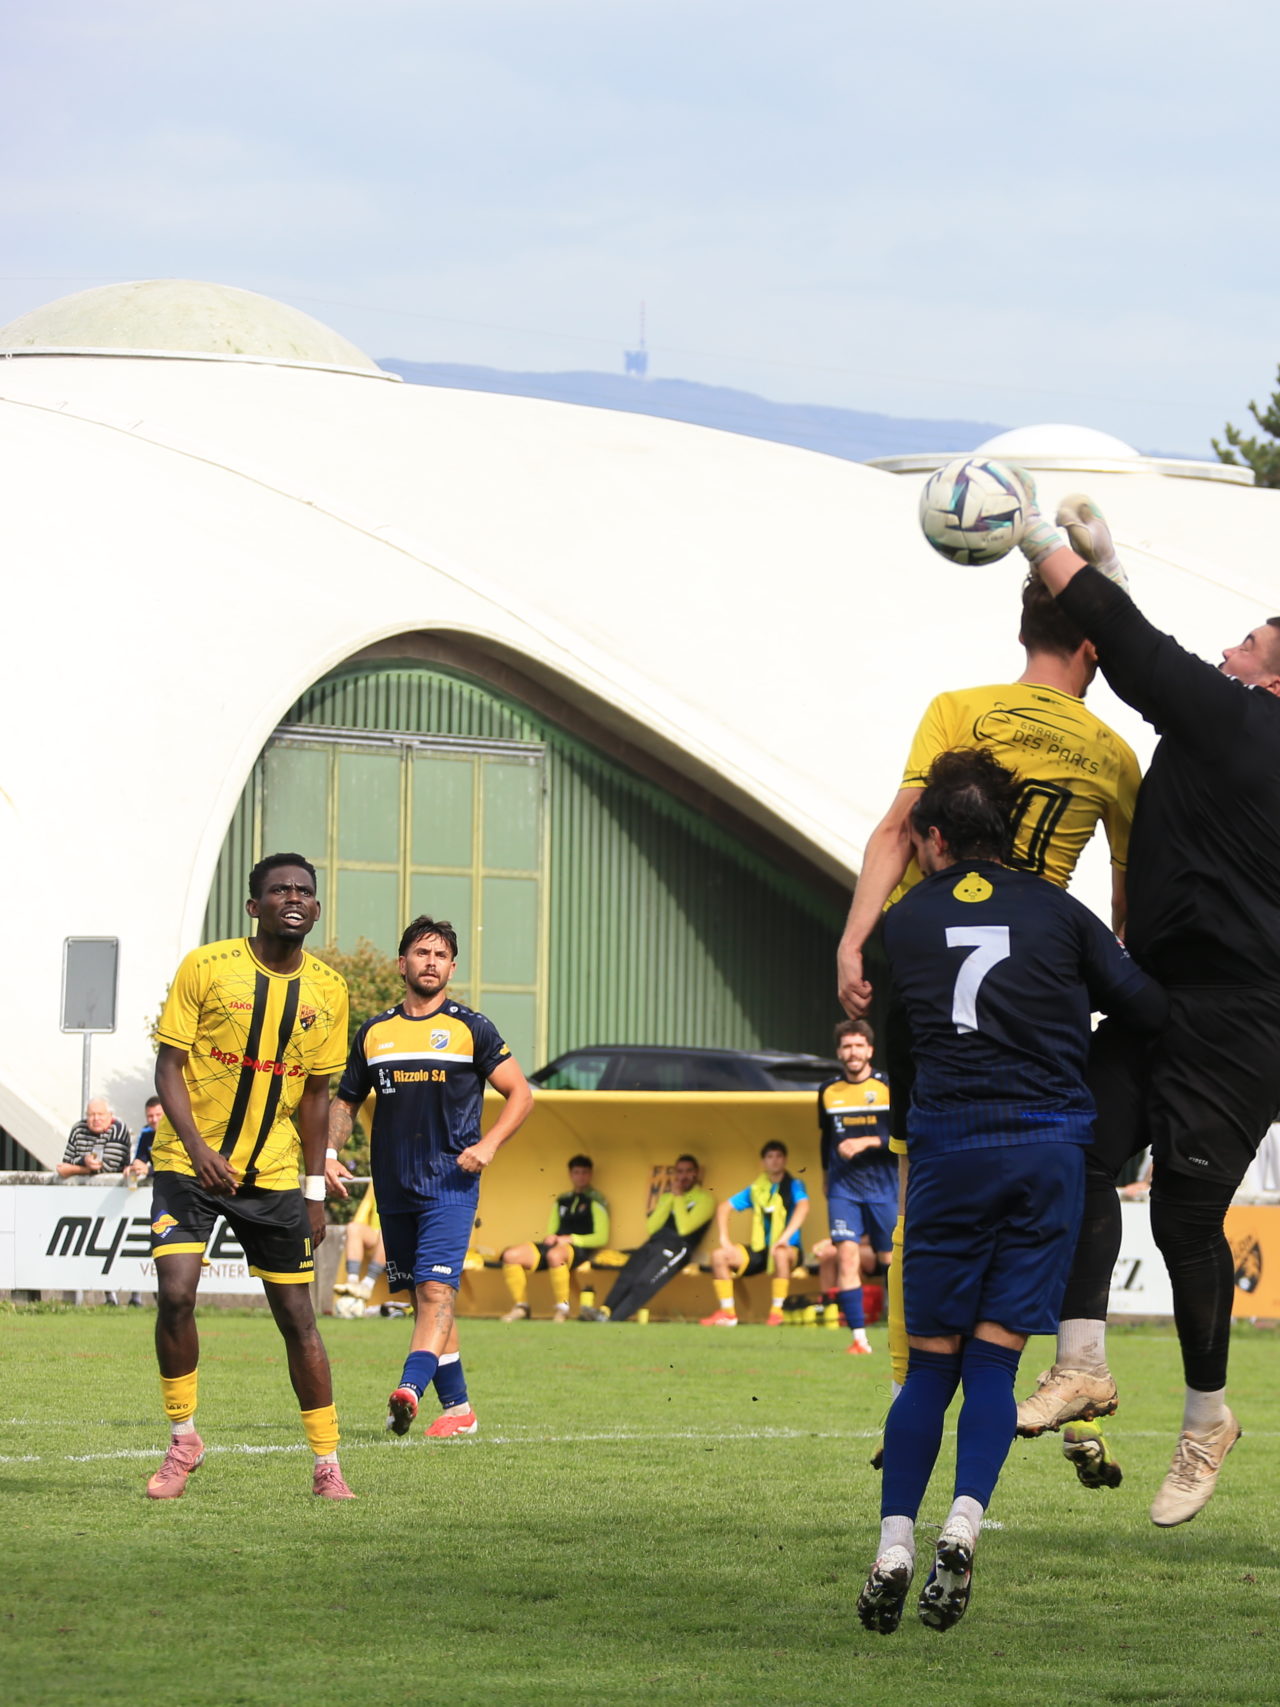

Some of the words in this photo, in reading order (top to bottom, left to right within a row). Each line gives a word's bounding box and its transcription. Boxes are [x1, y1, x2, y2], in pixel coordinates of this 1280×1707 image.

[1020, 721, 1066, 744] GARAGE
[1012, 729, 1044, 750] DES
[1046, 743, 1100, 775] PARCS
[945, 926, 1010, 1034] 7
[228, 1001, 253, 1011] JAKO
[393, 1069, 429, 1083] Rizzolo
[431, 1069, 447, 1083] SA
[304, 1237, 312, 1257] 11
